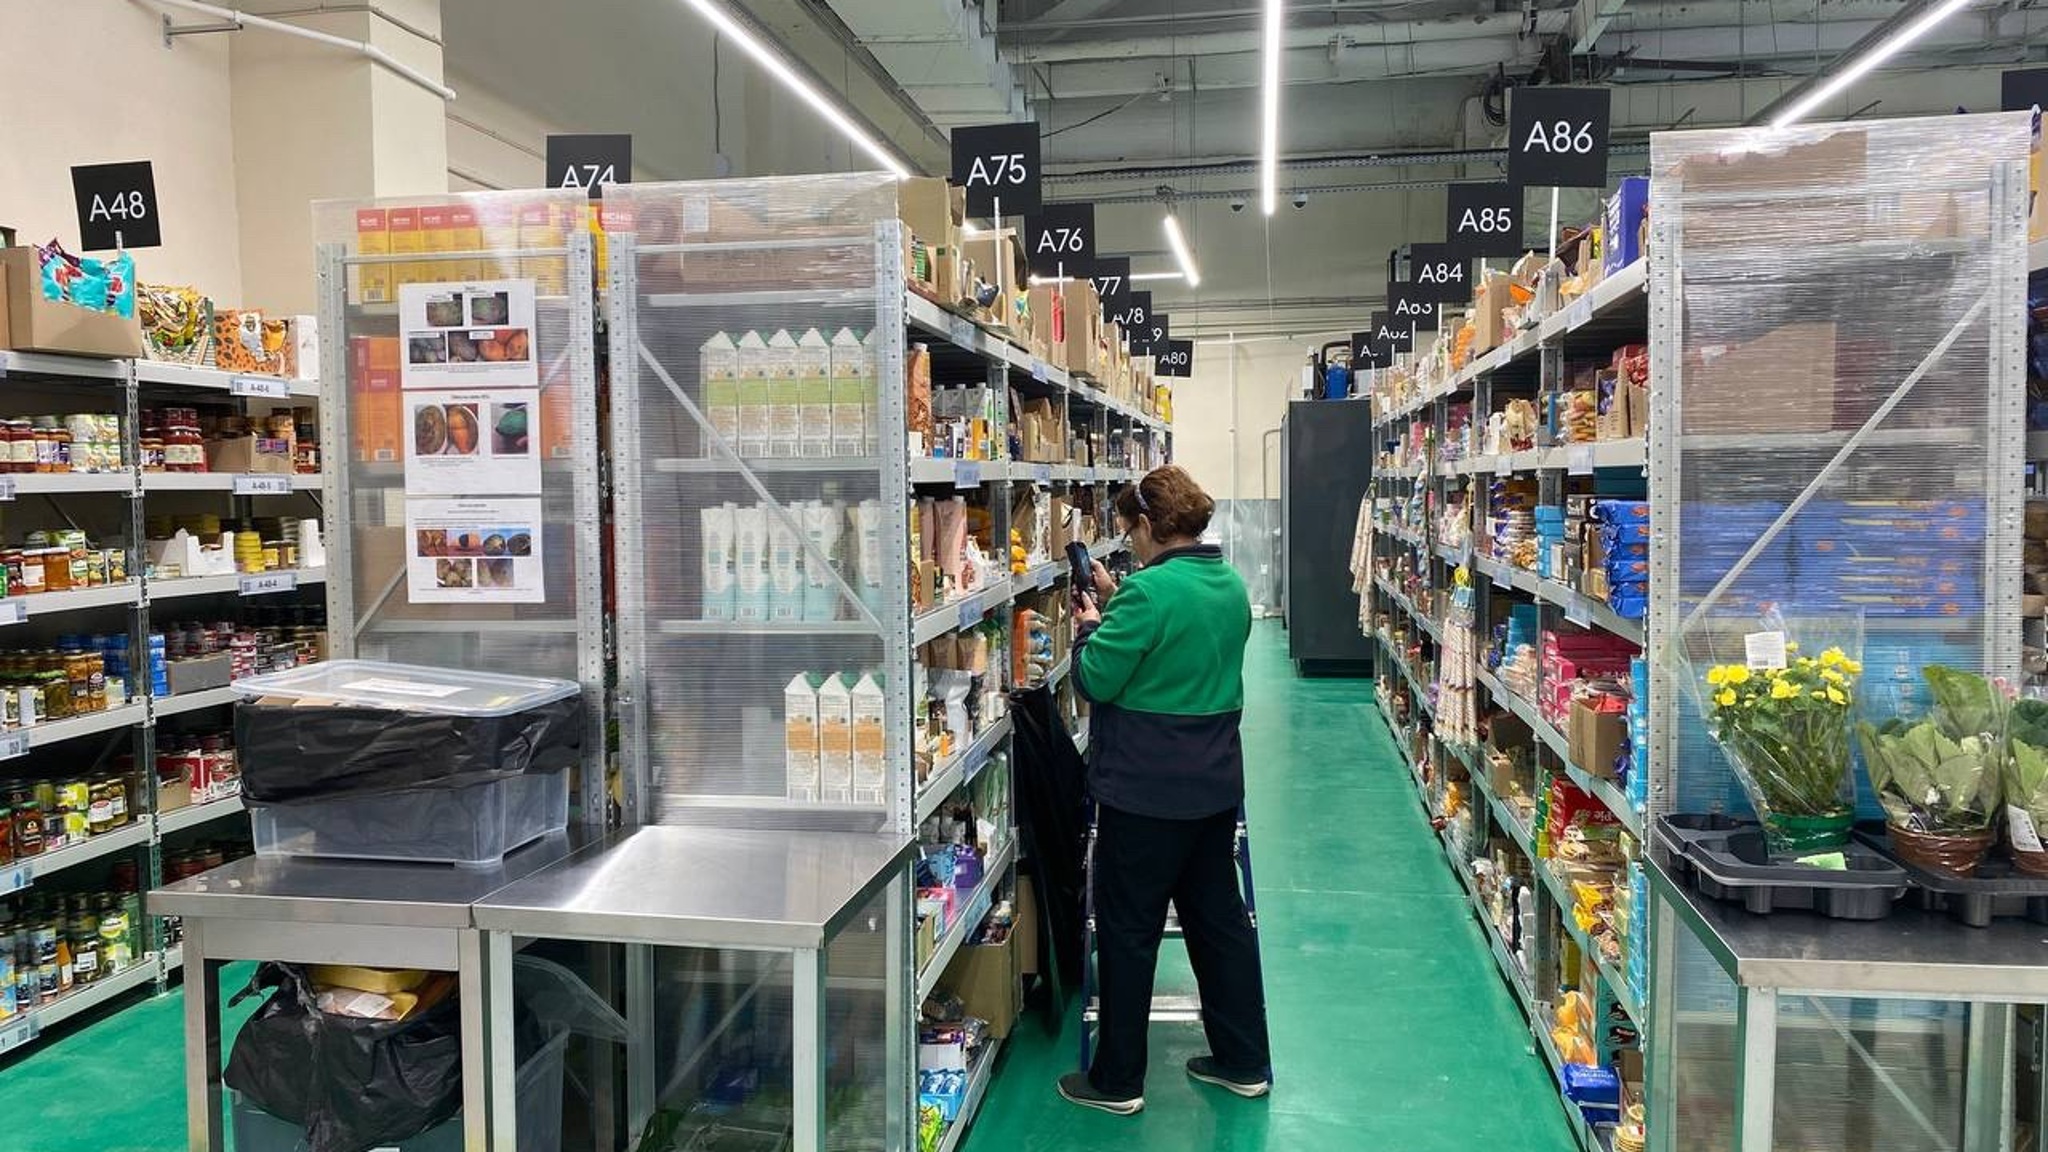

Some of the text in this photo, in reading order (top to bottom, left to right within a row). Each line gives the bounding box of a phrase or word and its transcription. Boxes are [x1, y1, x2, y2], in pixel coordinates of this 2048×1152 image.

[1523, 120, 1594, 153] A86
[966, 153, 1027, 188] A75
[89, 190, 146, 222] A48
[1458, 207, 1512, 233] A85
[1036, 227, 1084, 254] A76
[1418, 262, 1463, 284] A84
[1160, 351, 1188, 365] A80
